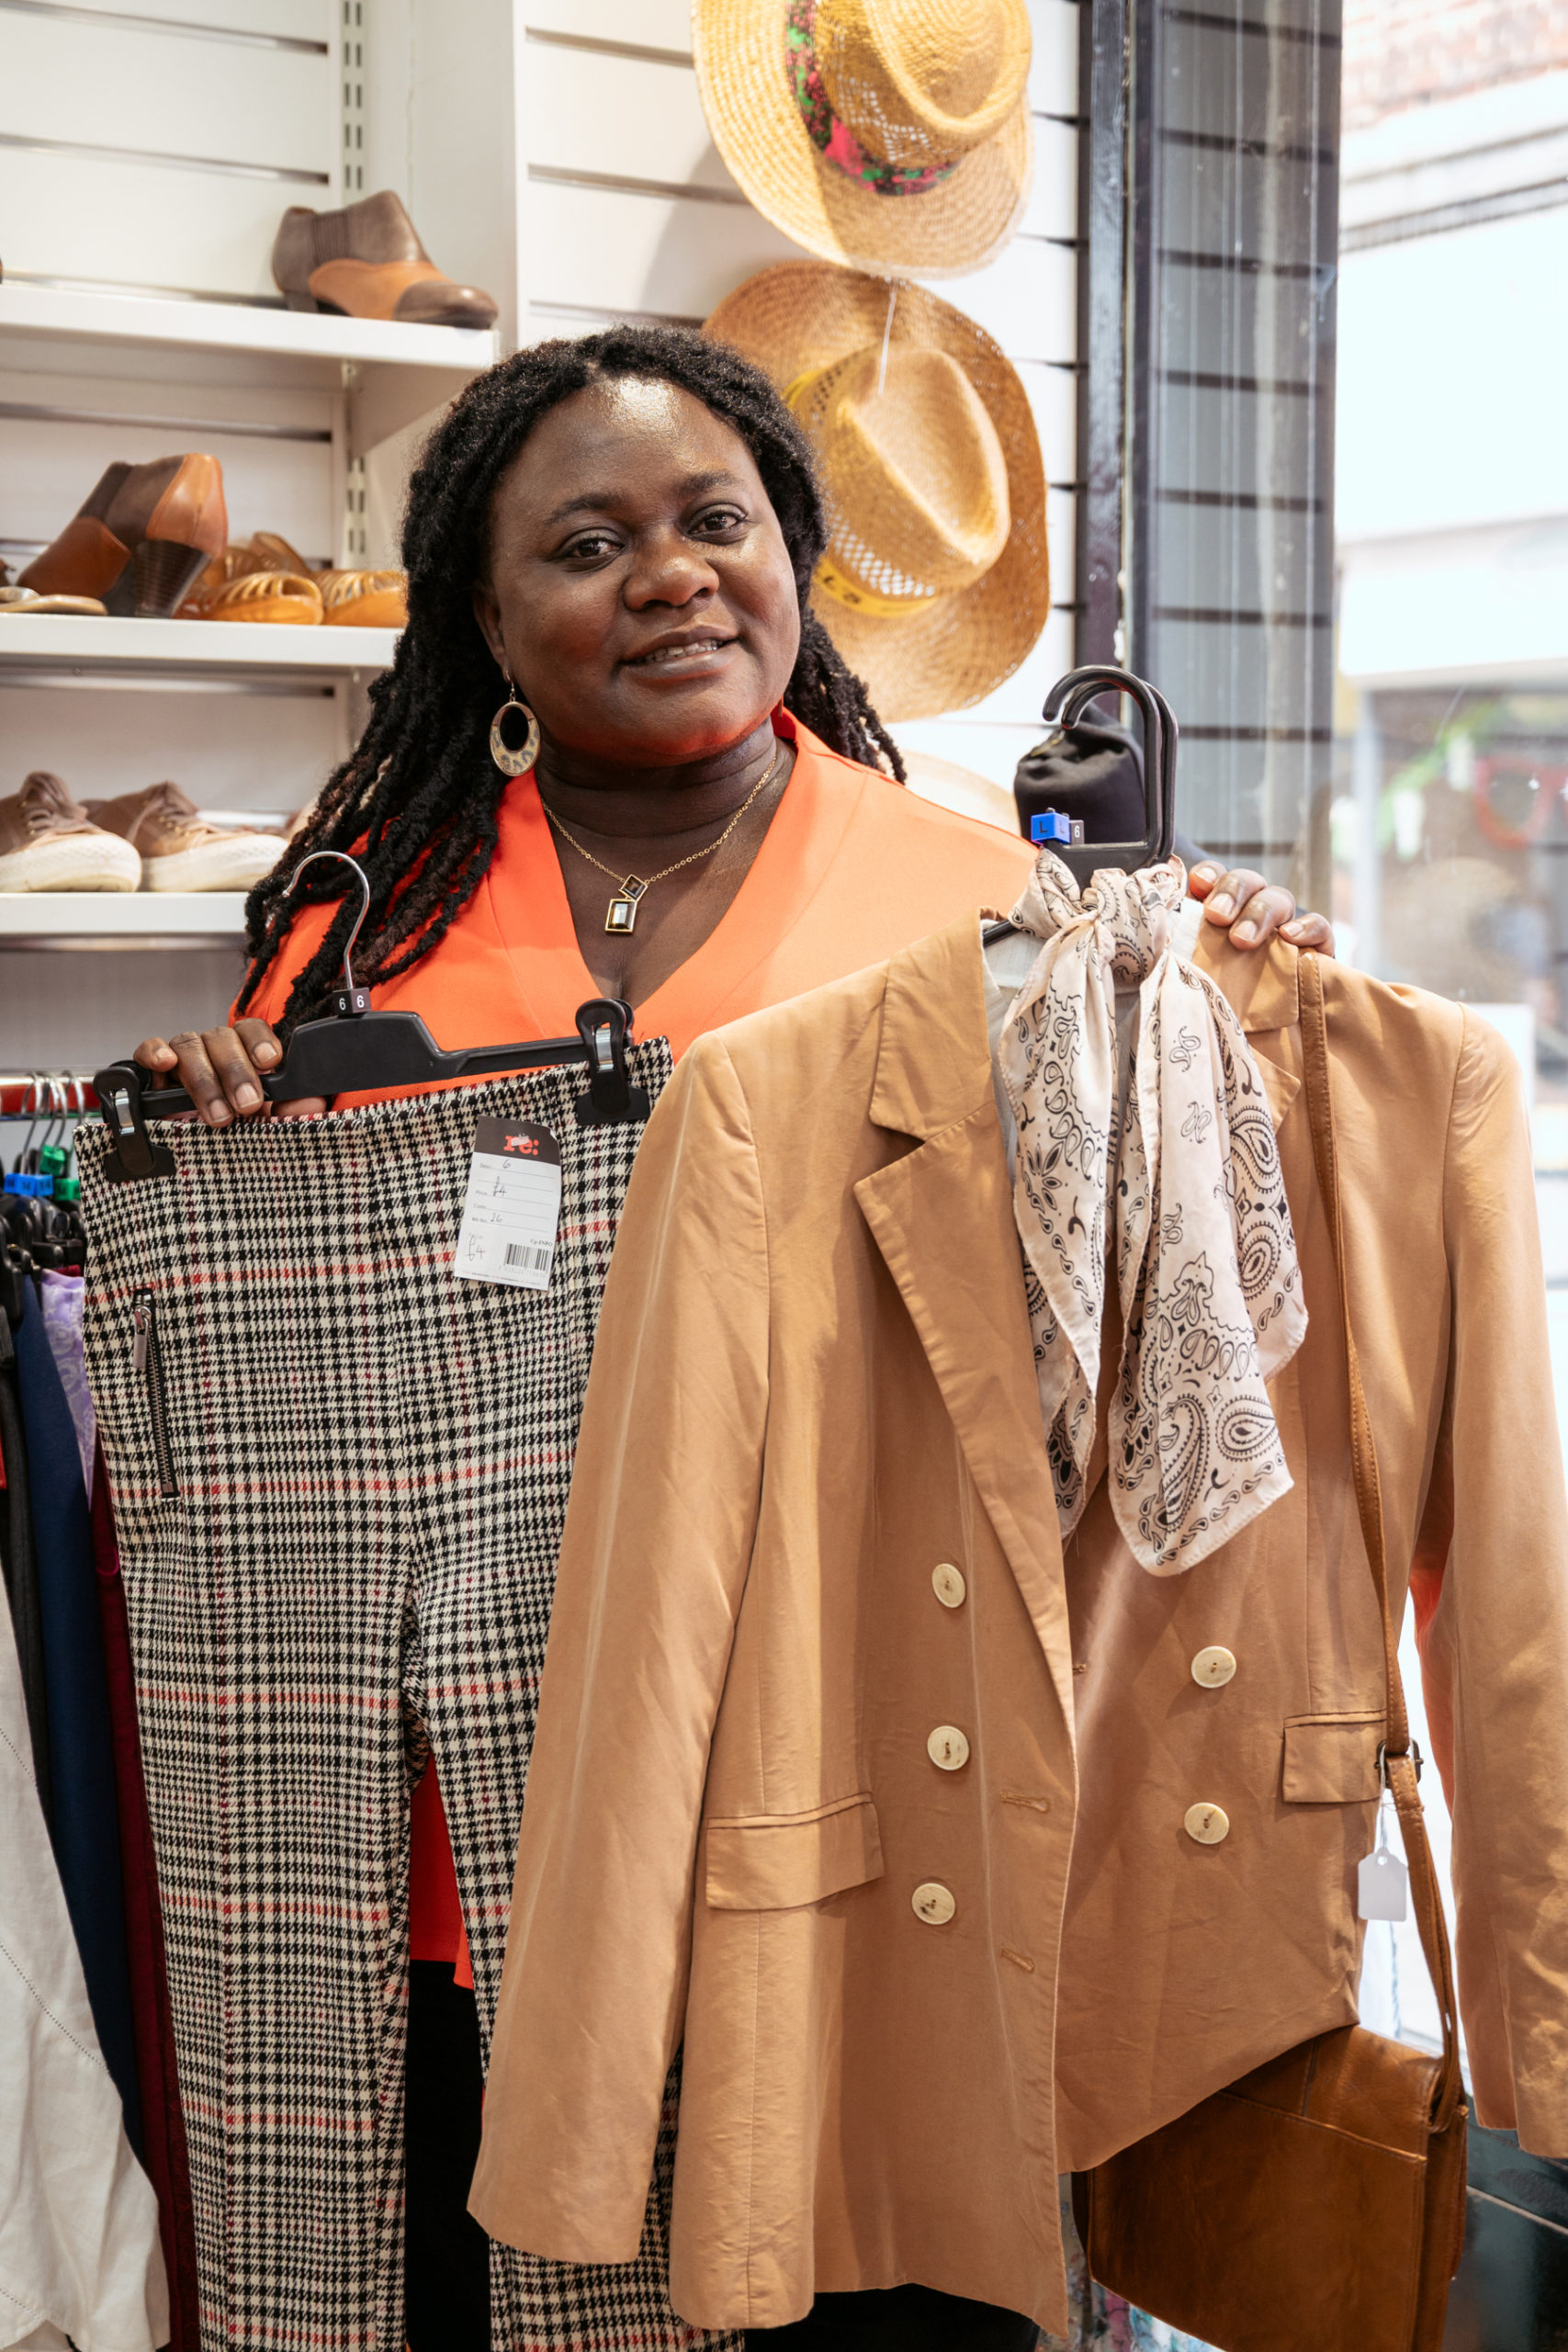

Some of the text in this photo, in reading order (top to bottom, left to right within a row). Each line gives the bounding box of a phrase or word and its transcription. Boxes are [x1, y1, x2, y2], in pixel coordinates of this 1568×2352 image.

[1039, 820, 1048, 833] L
[1074, 824, 1080, 838] 6
[339, 997, 346, 1011] 6
[356, 994, 365, 1008] 6
[502, 1159, 512, 1169] 6
[464, 1234, 485, 1261] £4
